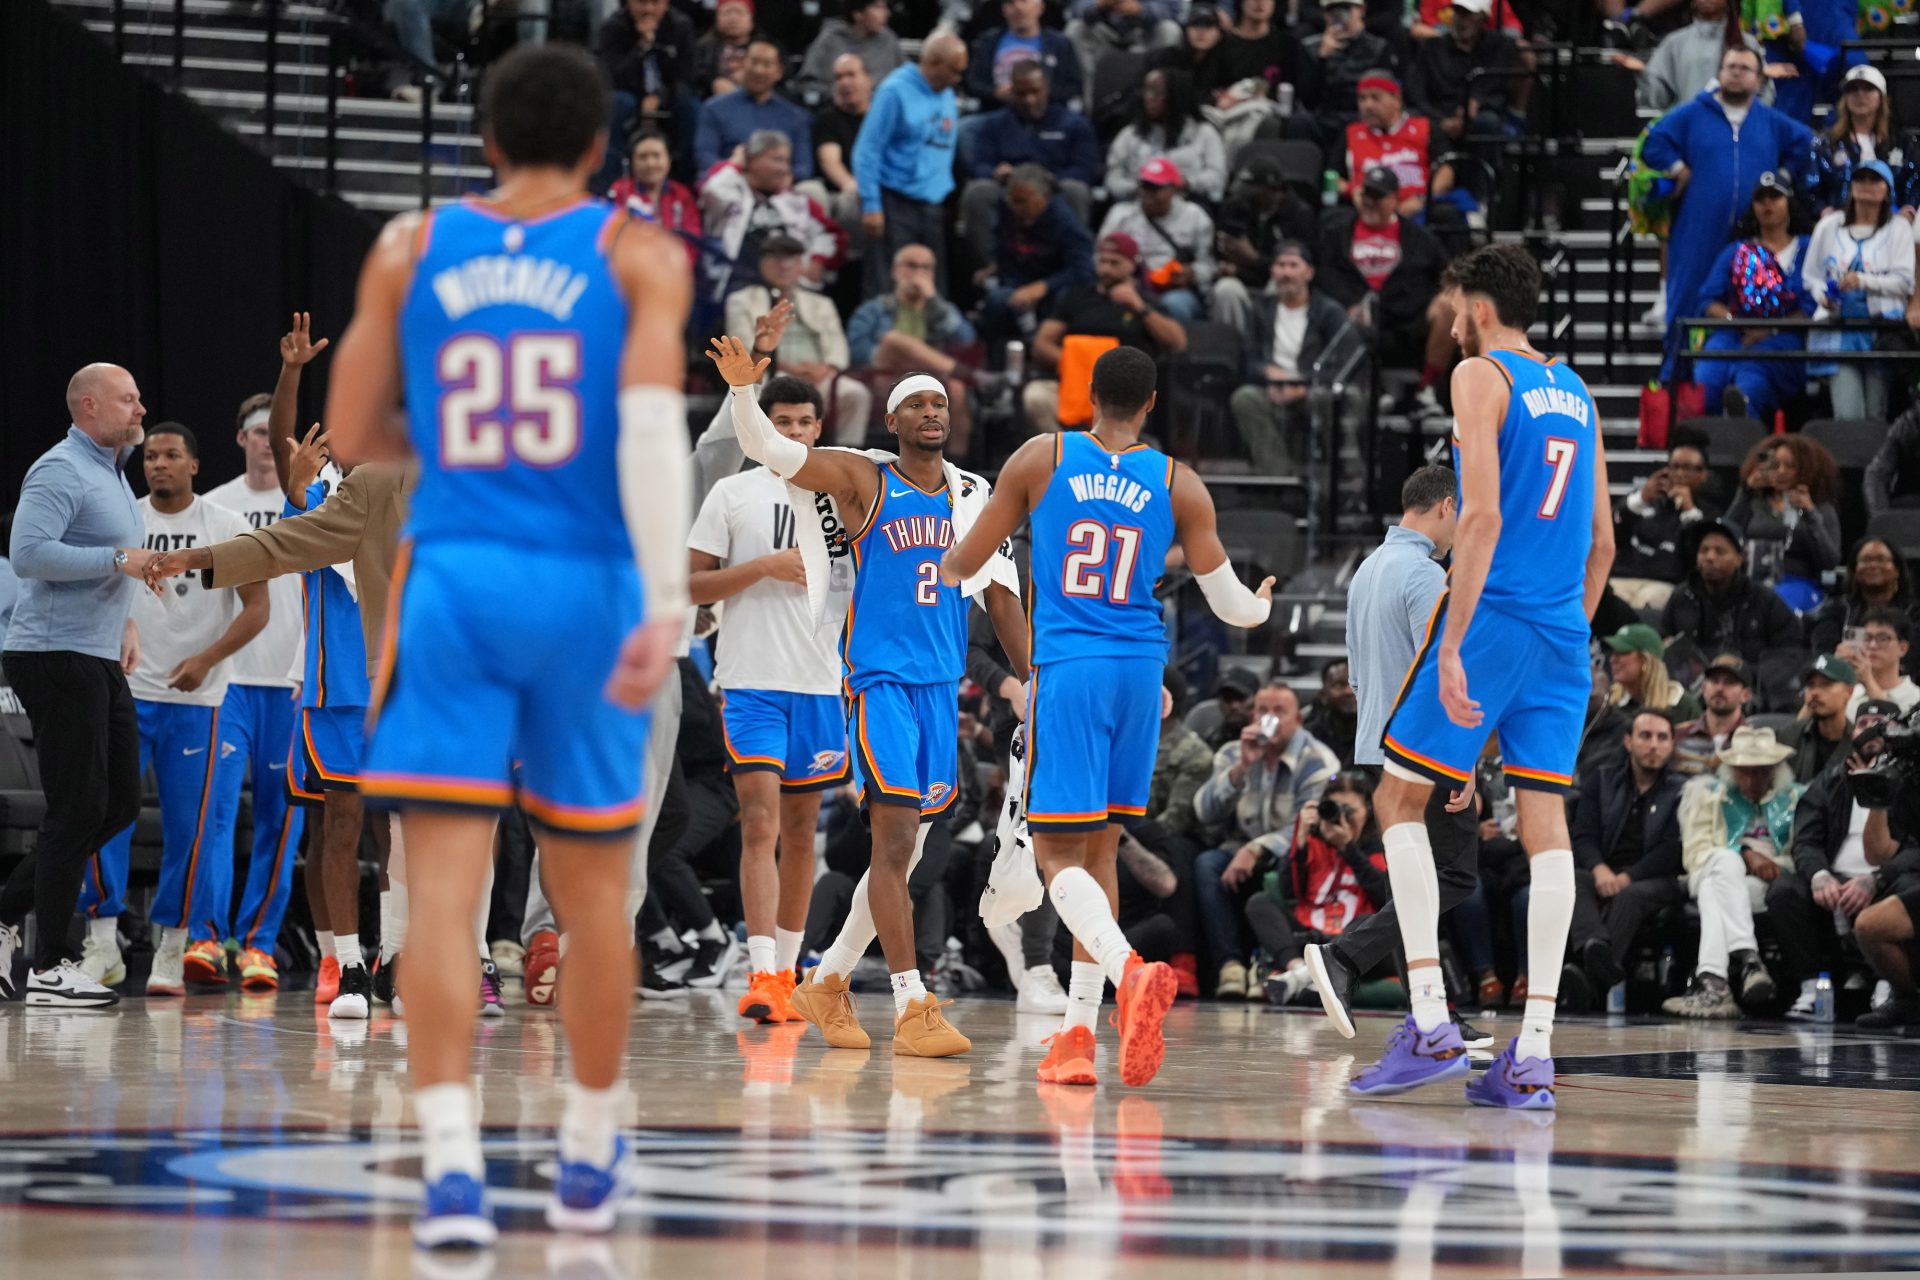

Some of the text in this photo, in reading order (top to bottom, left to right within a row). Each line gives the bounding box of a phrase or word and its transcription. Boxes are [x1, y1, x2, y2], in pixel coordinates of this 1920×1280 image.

[436, 329, 582, 470] 25
[1522, 387, 1588, 428] HOLMGREN
[1068, 473, 1152, 513] WIGGINS
[1537, 436, 1577, 519] 7
[916, 560, 939, 606] 2
[1062, 518, 1143, 604] 21
